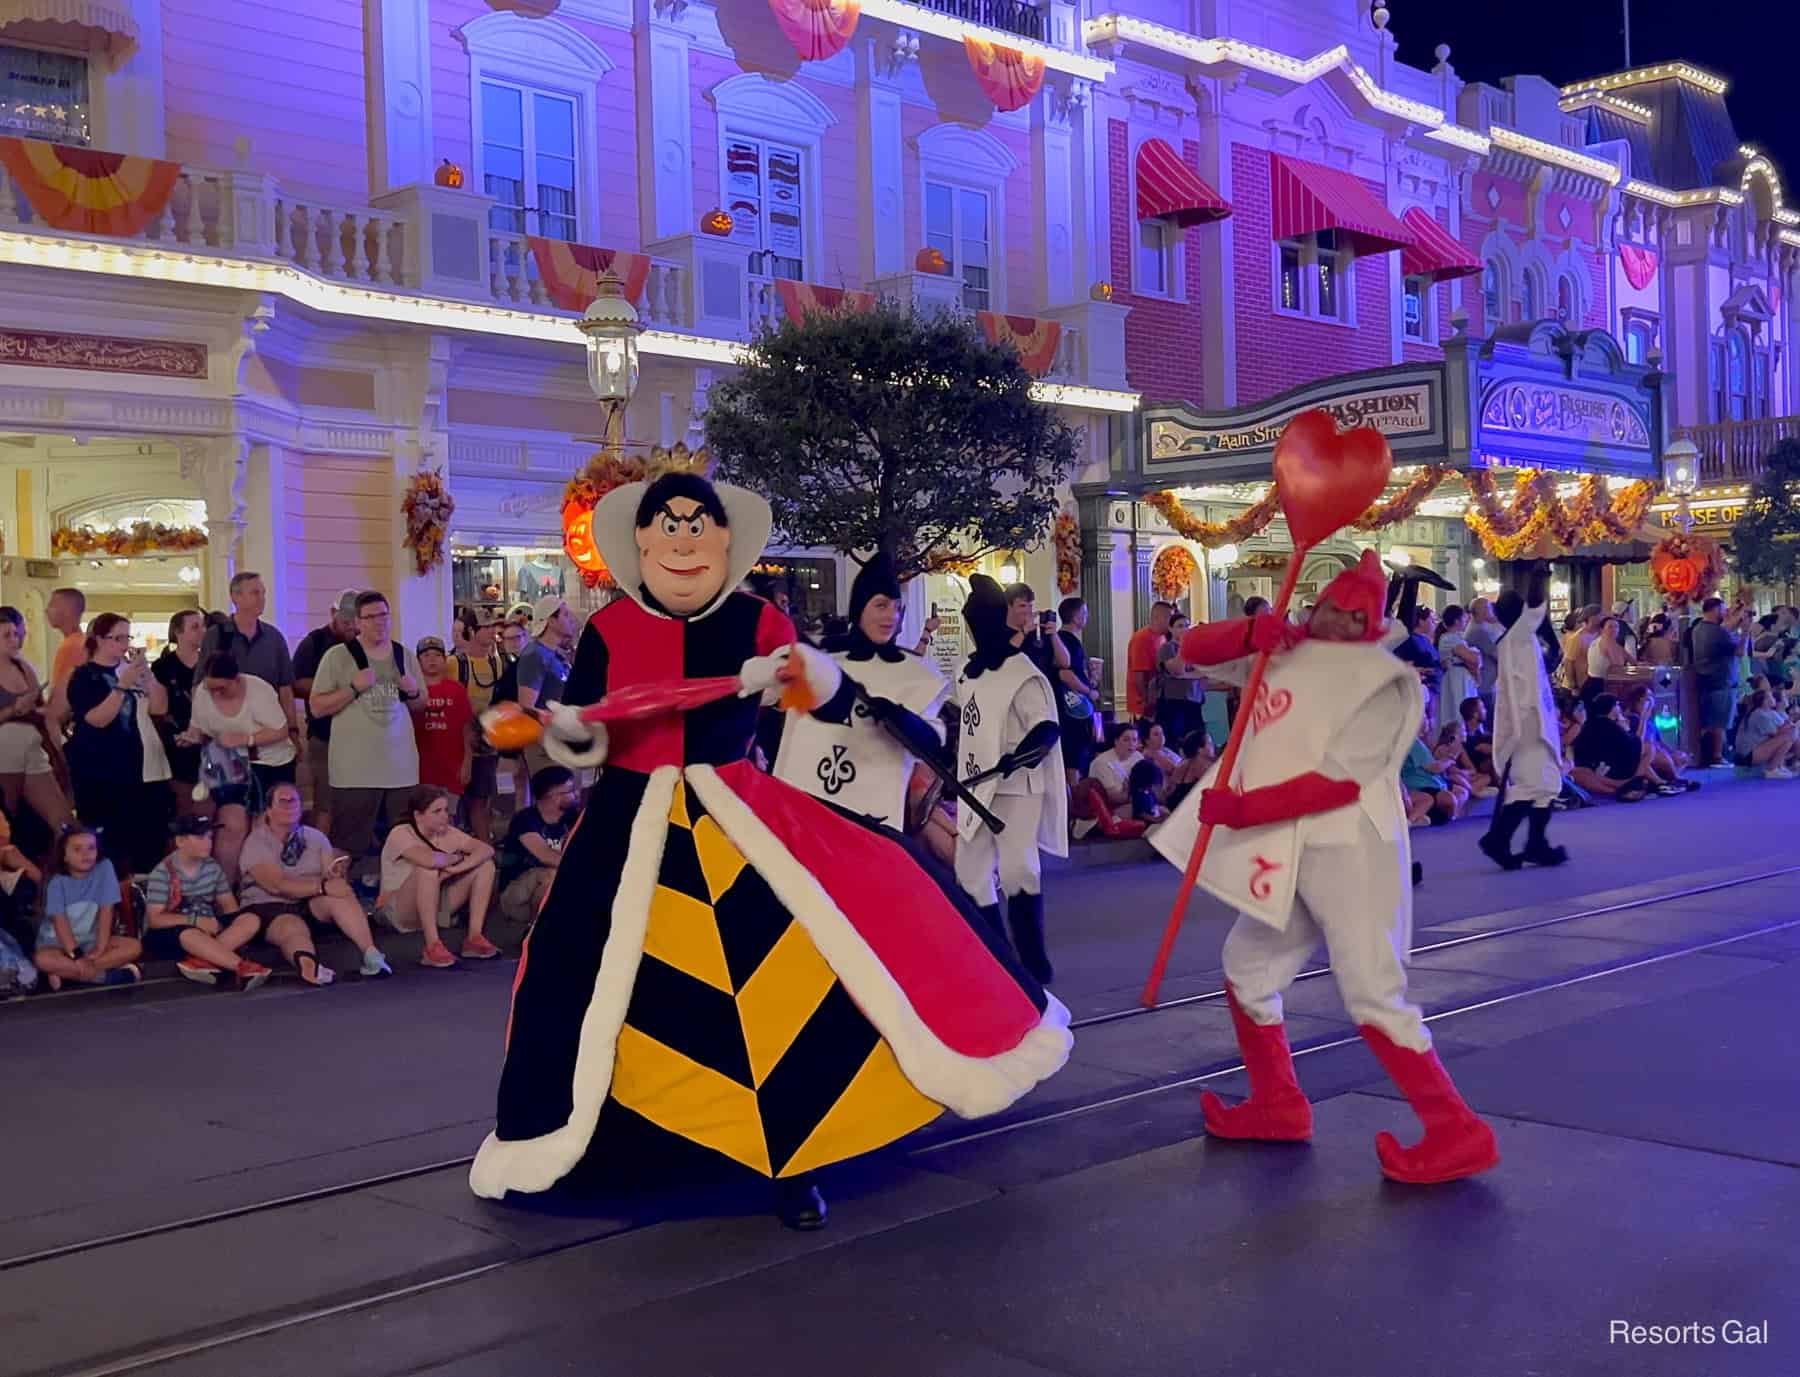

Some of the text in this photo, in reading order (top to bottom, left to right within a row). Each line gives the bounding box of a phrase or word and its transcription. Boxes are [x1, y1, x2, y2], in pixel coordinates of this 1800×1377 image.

[1366, 415, 1425, 430] APPAREL
[1216, 431, 1250, 449] Main
[1721, 506, 1744, 523] OF
